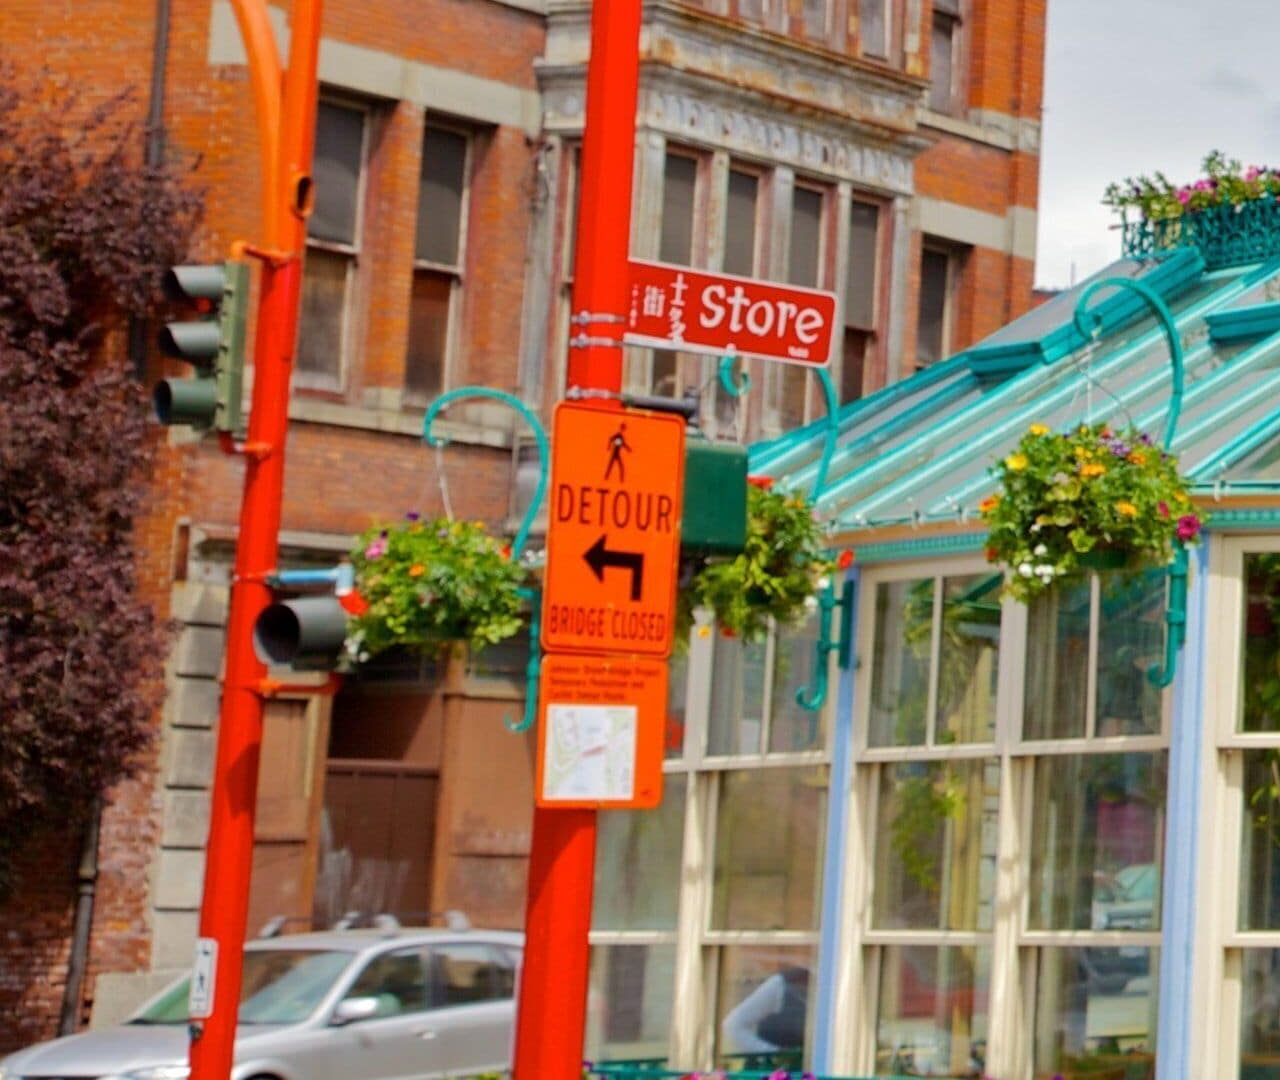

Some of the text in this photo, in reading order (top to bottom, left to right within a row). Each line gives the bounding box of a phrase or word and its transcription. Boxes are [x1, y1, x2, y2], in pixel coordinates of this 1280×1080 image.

[700, 284, 824, 344] Store
[557, 483, 673, 533] DETOUR
[550, 605, 665, 641] BRIDGE CLOSED
